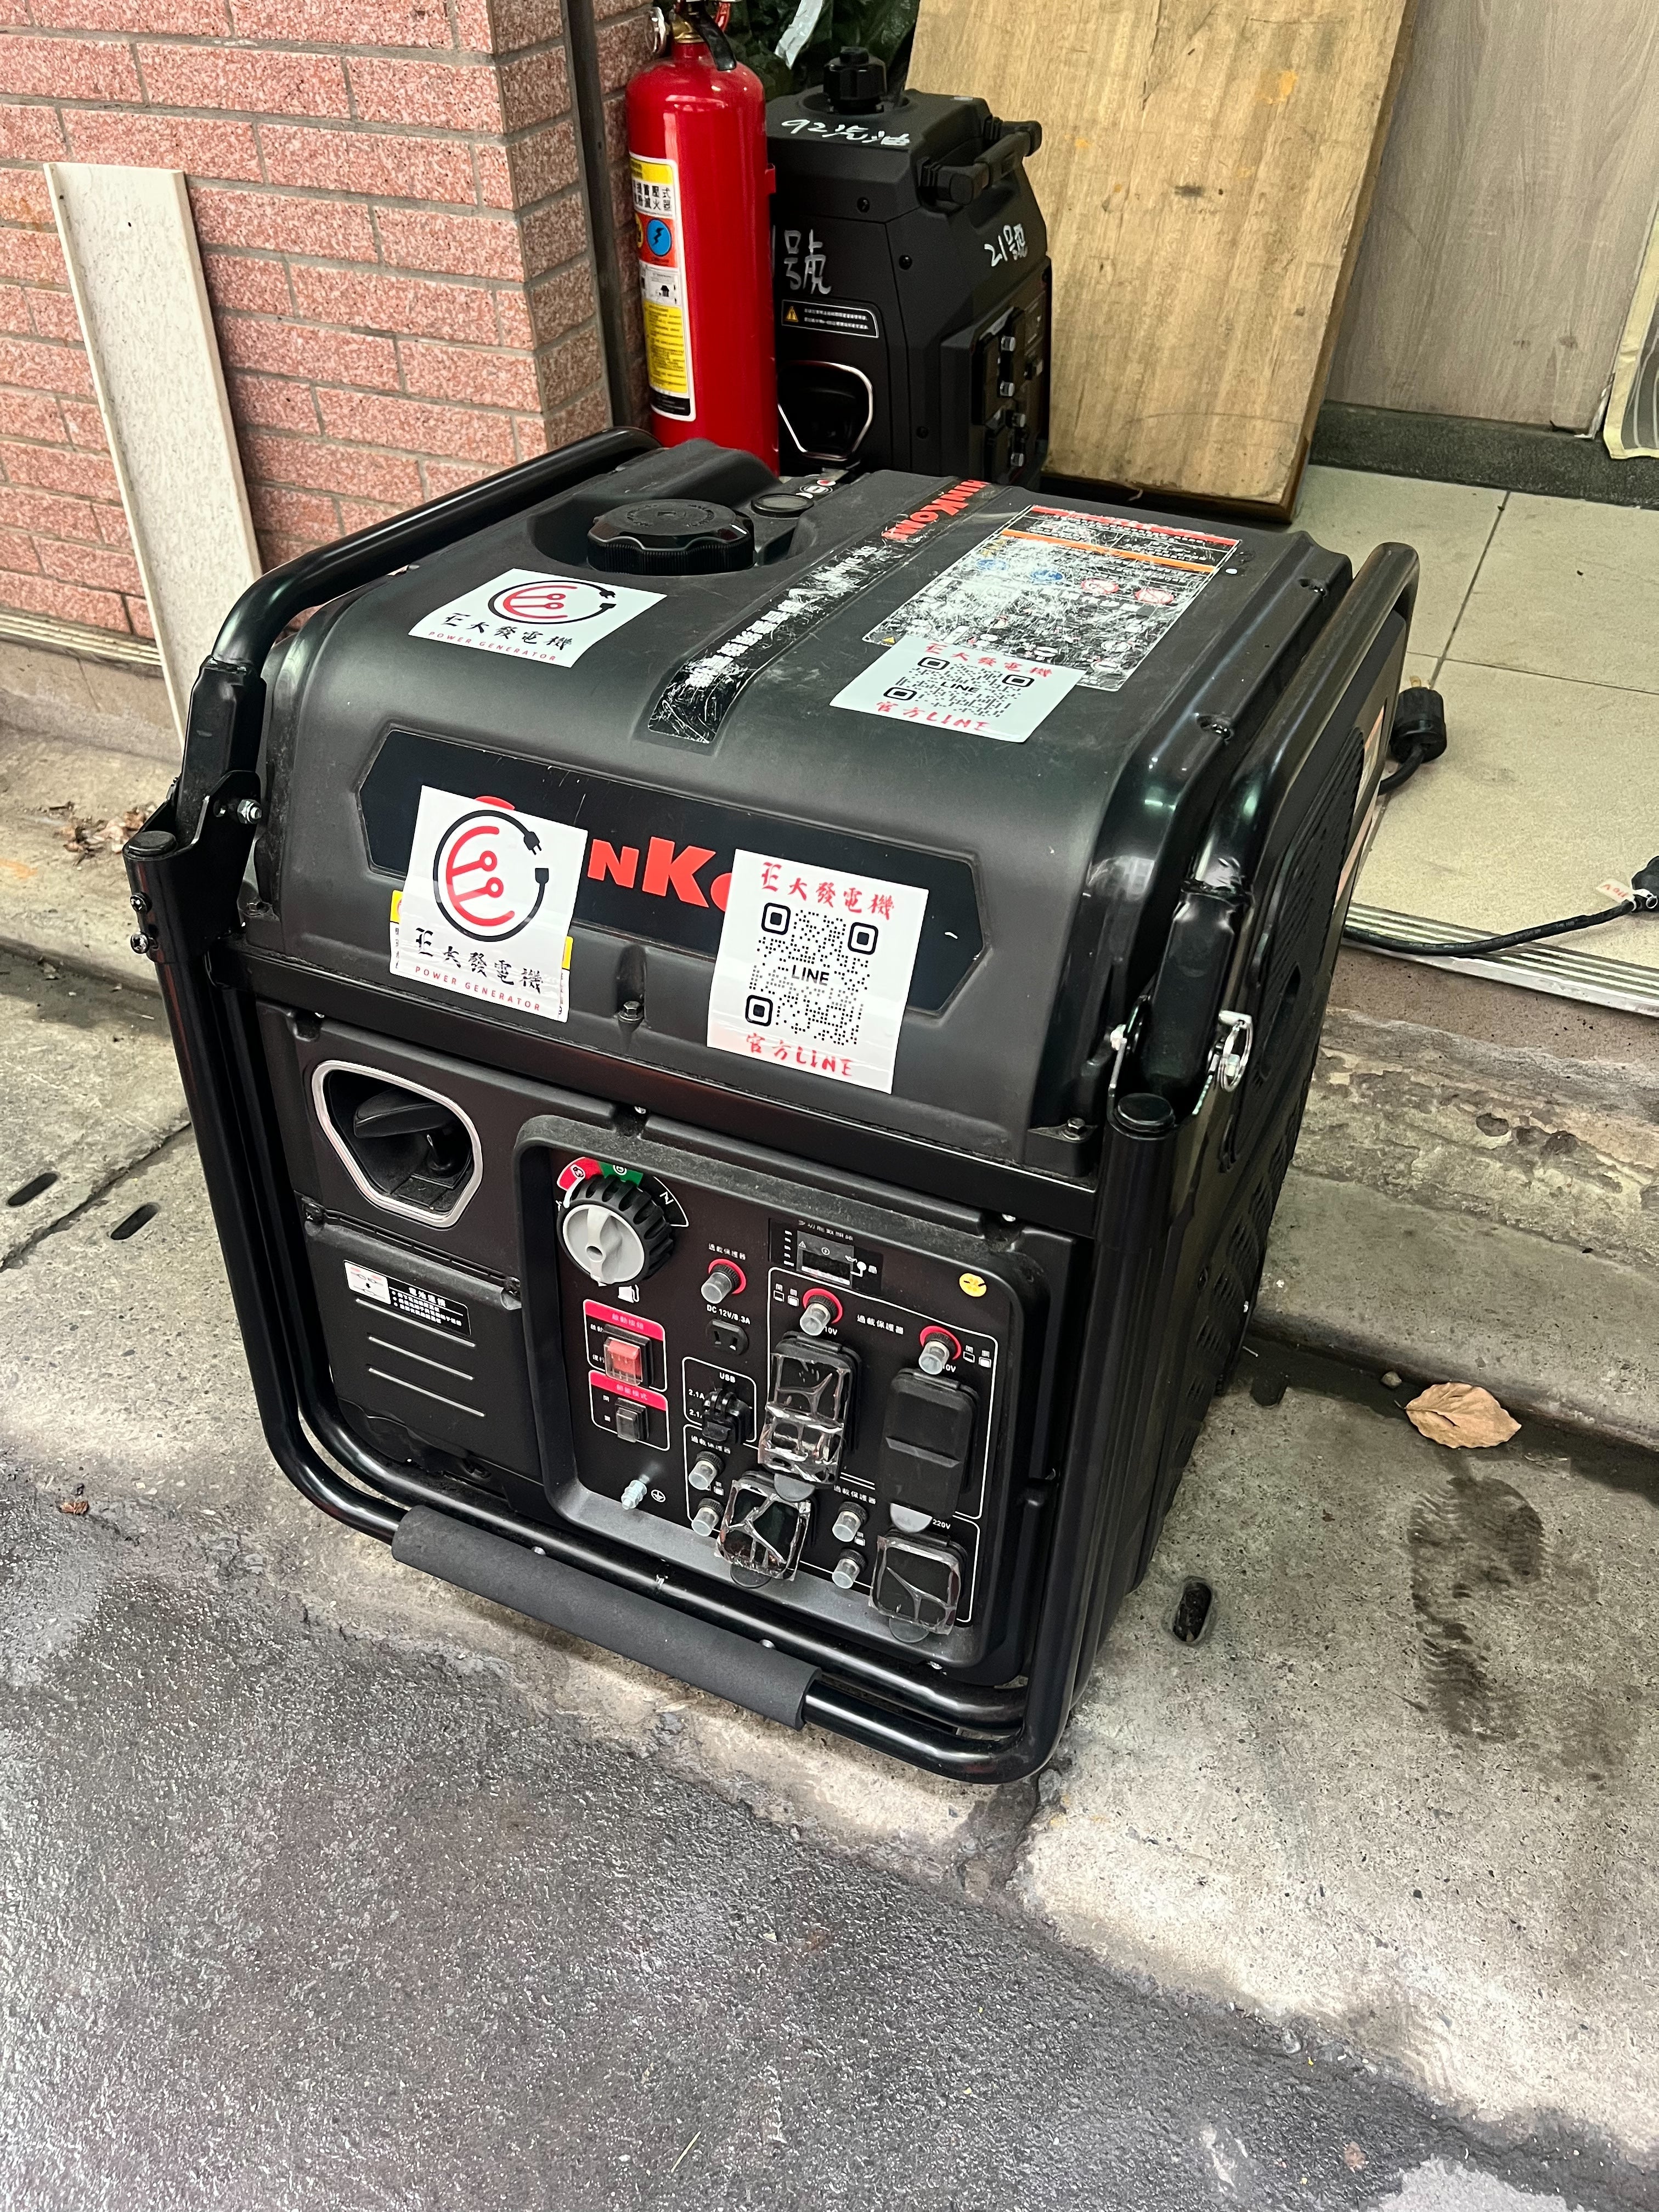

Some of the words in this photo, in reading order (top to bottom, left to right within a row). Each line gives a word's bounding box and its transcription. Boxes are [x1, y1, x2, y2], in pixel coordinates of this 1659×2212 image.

[428, 631, 472, 644] POWER
[478, 640, 556, 662] GENERATOR
[940, 681, 980, 693] LINE
[791, 964, 830, 986] LINE
[415, 966, 457, 985] POWER
[465, 981, 540, 1012] GENERATOR
[707, 1304, 717, 1313] DC
[719, 1308, 751, 1325] 12V/8.3A
[719, 1372, 736, 1383] USB
[688, 1389, 705, 1400] 2.1A
[933, 1519, 951, 1530] 220V
